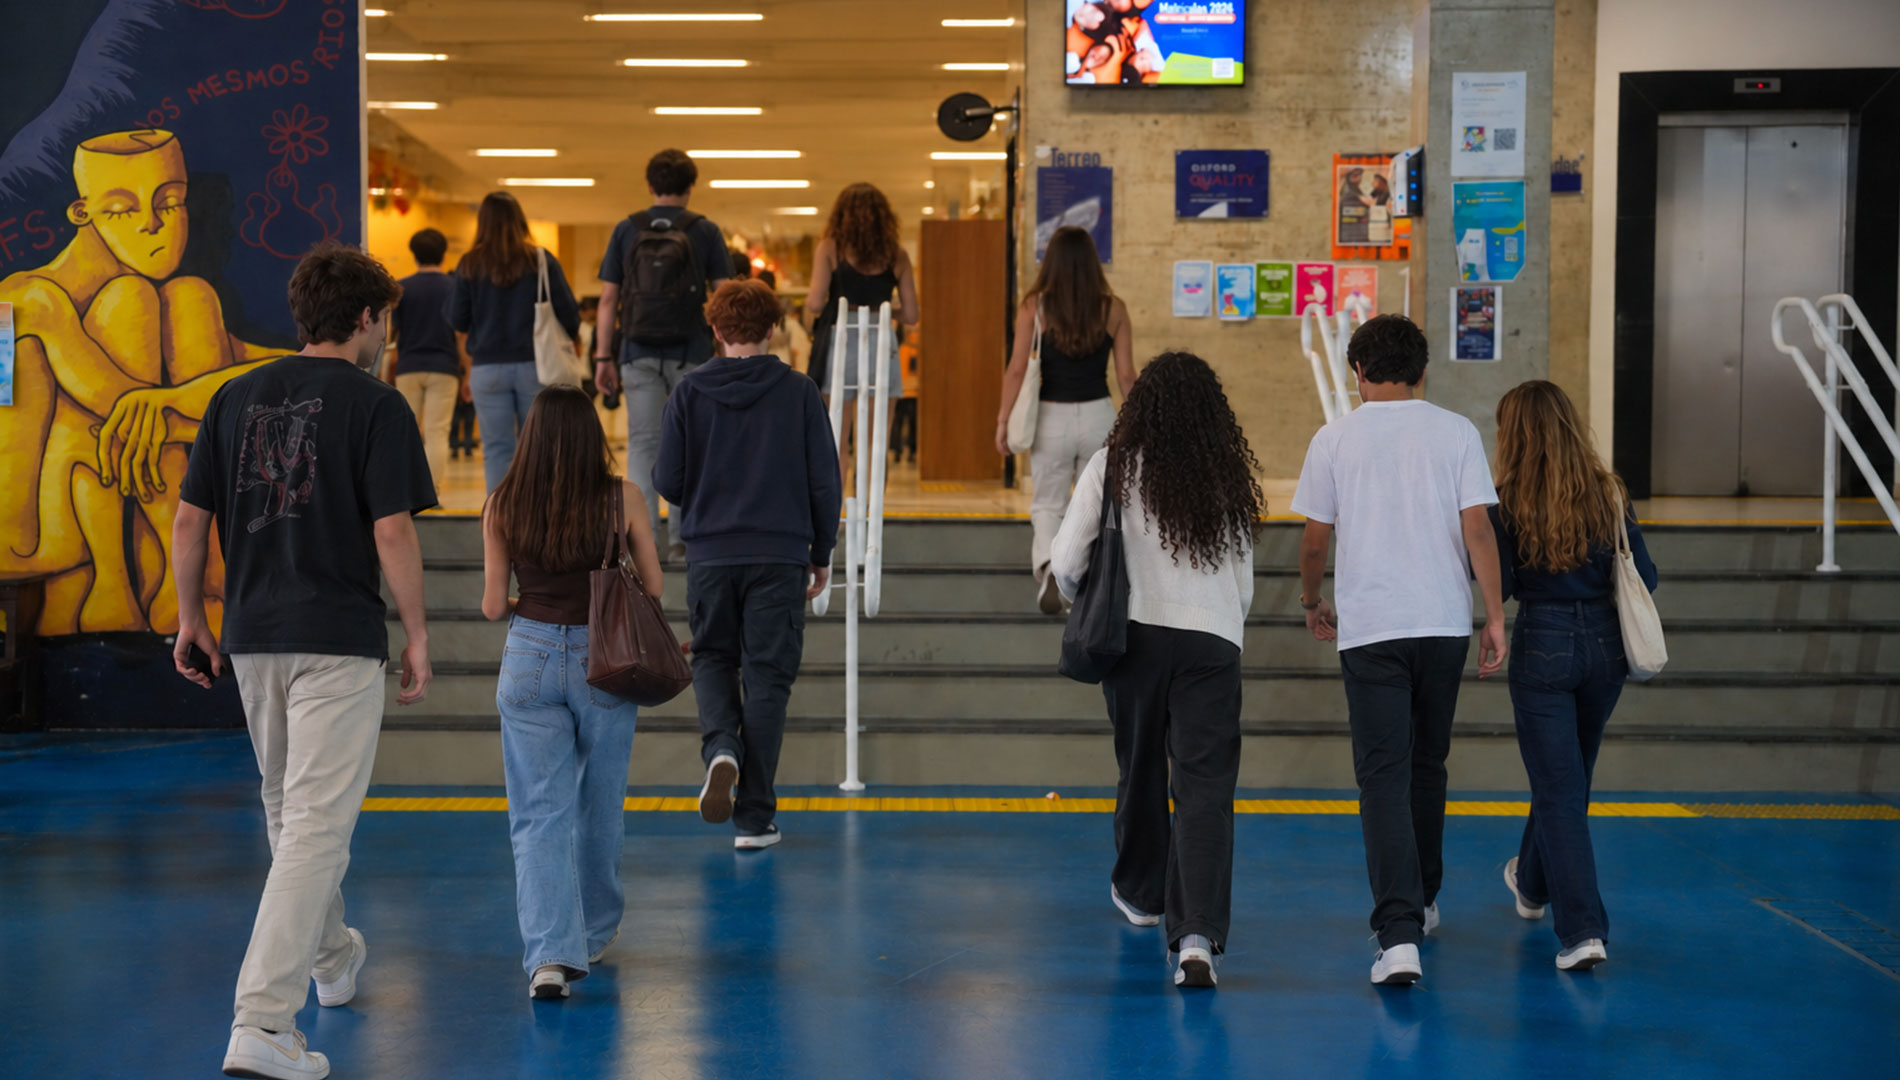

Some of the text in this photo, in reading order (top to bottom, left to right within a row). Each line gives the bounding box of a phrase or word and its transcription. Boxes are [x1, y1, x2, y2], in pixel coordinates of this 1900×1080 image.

[186, 59, 310, 105] MESMOS
[312, 0, 345, 70] RIO
[1189, 173, 1255, 191] QUALITY
